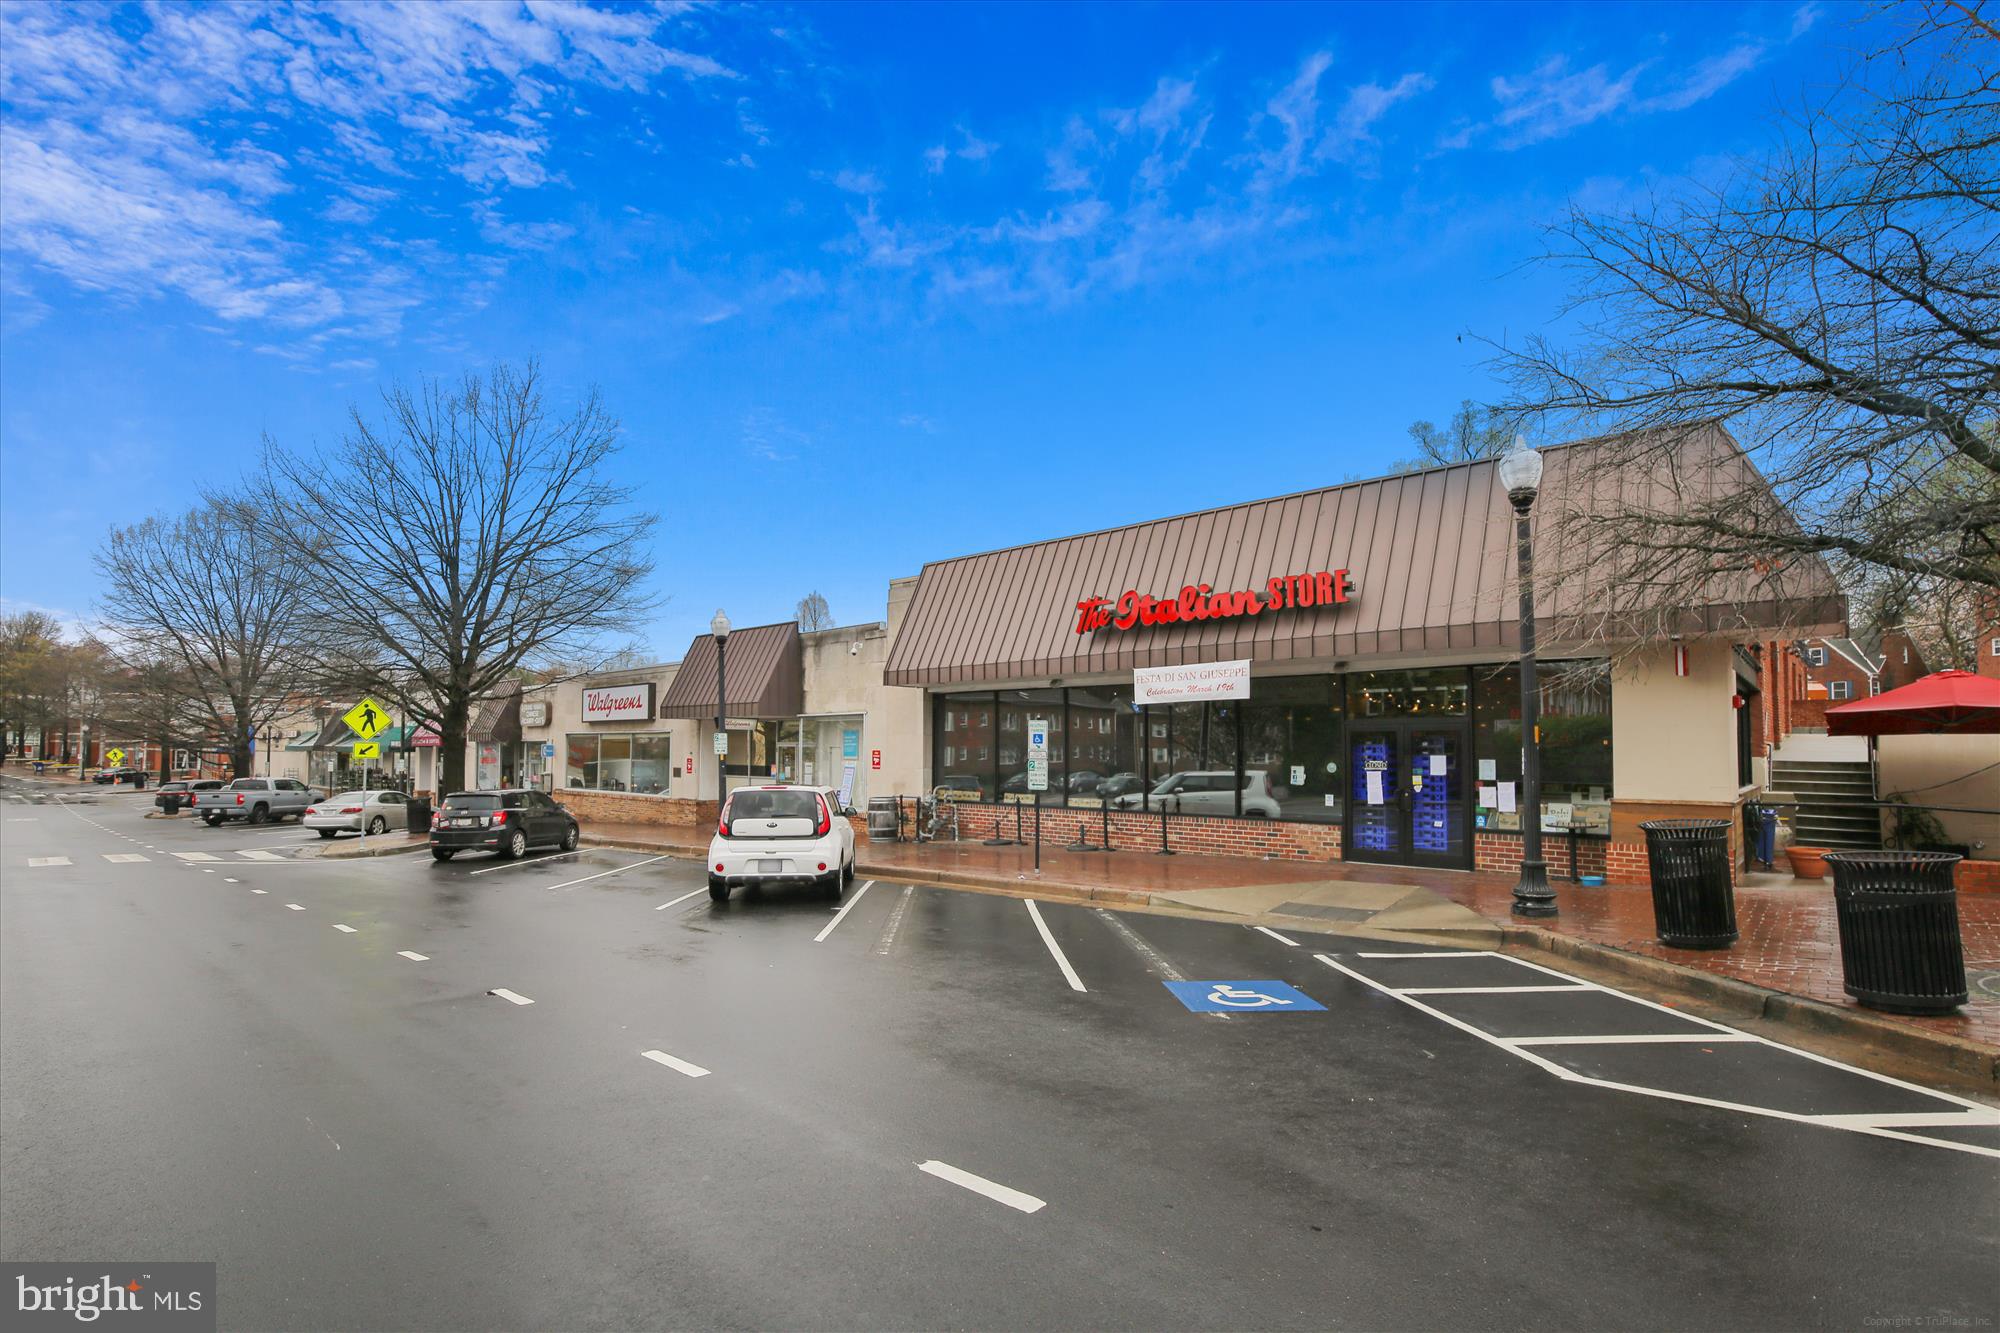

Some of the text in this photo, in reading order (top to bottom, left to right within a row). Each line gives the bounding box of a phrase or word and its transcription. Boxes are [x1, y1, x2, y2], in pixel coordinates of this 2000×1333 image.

[1075, 569, 1350, 634] The Italian STORE
[1136, 667, 1248, 684] FESTA DI SAN GIUSEPPE
[1146, 682, 1235, 697] Celebration March 19th
[587, 692, 643, 717] Walgreens
